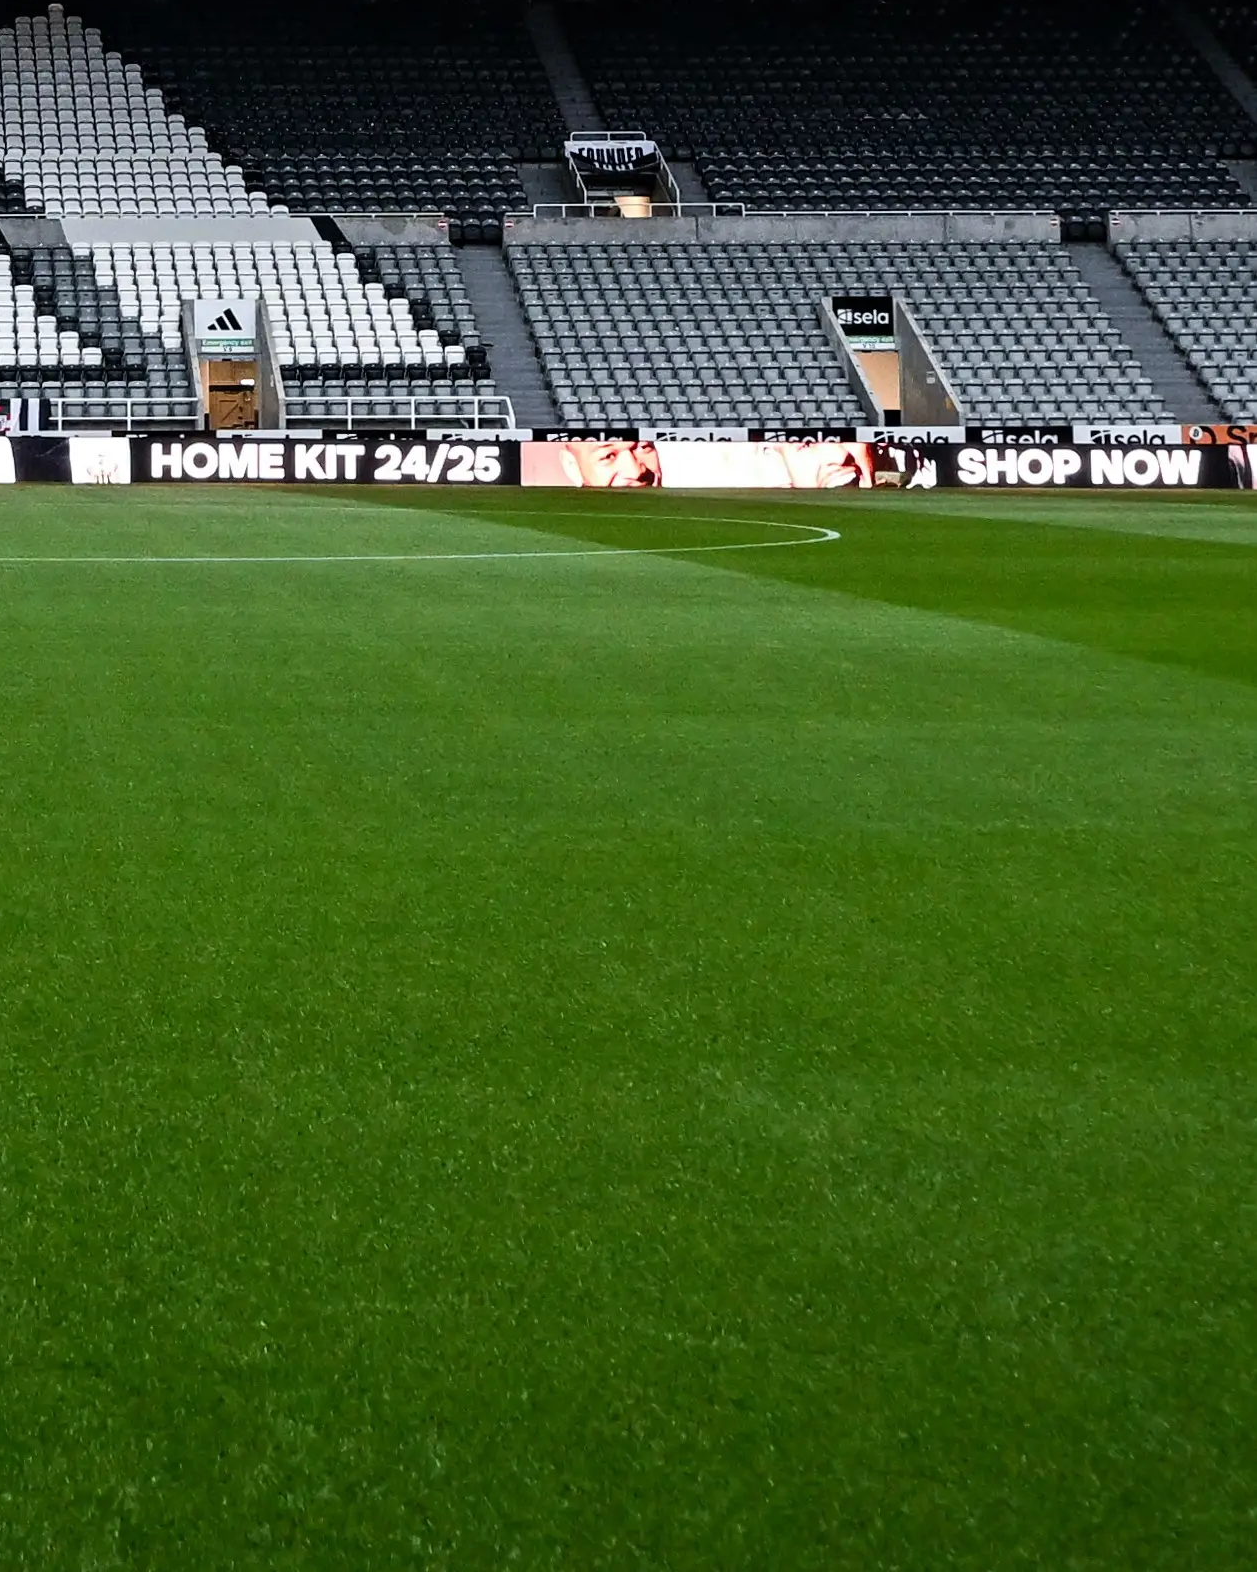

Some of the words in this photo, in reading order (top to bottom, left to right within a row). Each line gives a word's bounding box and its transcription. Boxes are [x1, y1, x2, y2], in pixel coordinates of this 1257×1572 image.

[853, 309, 889, 325] sela
[151, 442, 285, 479] HOME
[294, 443, 366, 479] KIT
[374, 443, 502, 482] 24/25
[957, 448, 1082, 485] SHOP
[1091, 449, 1202, 485] NOW
